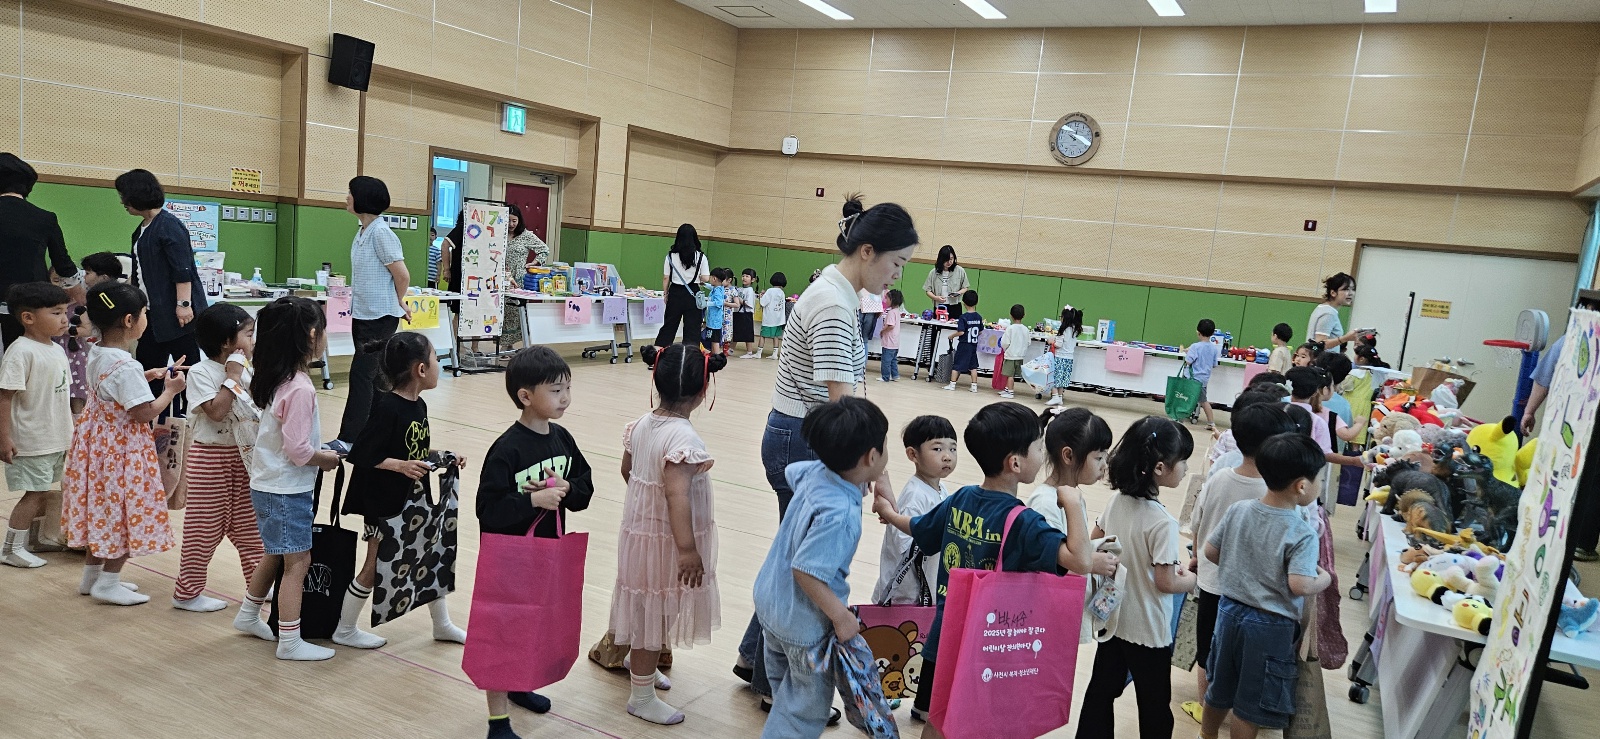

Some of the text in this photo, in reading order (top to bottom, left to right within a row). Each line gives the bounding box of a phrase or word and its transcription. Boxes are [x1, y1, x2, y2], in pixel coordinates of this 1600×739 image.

[967, 326, 979, 344] 19
[948, 506, 985, 540] NBA
[985, 528, 1002, 542] in
[983, 629, 1006, 637] 2025년
